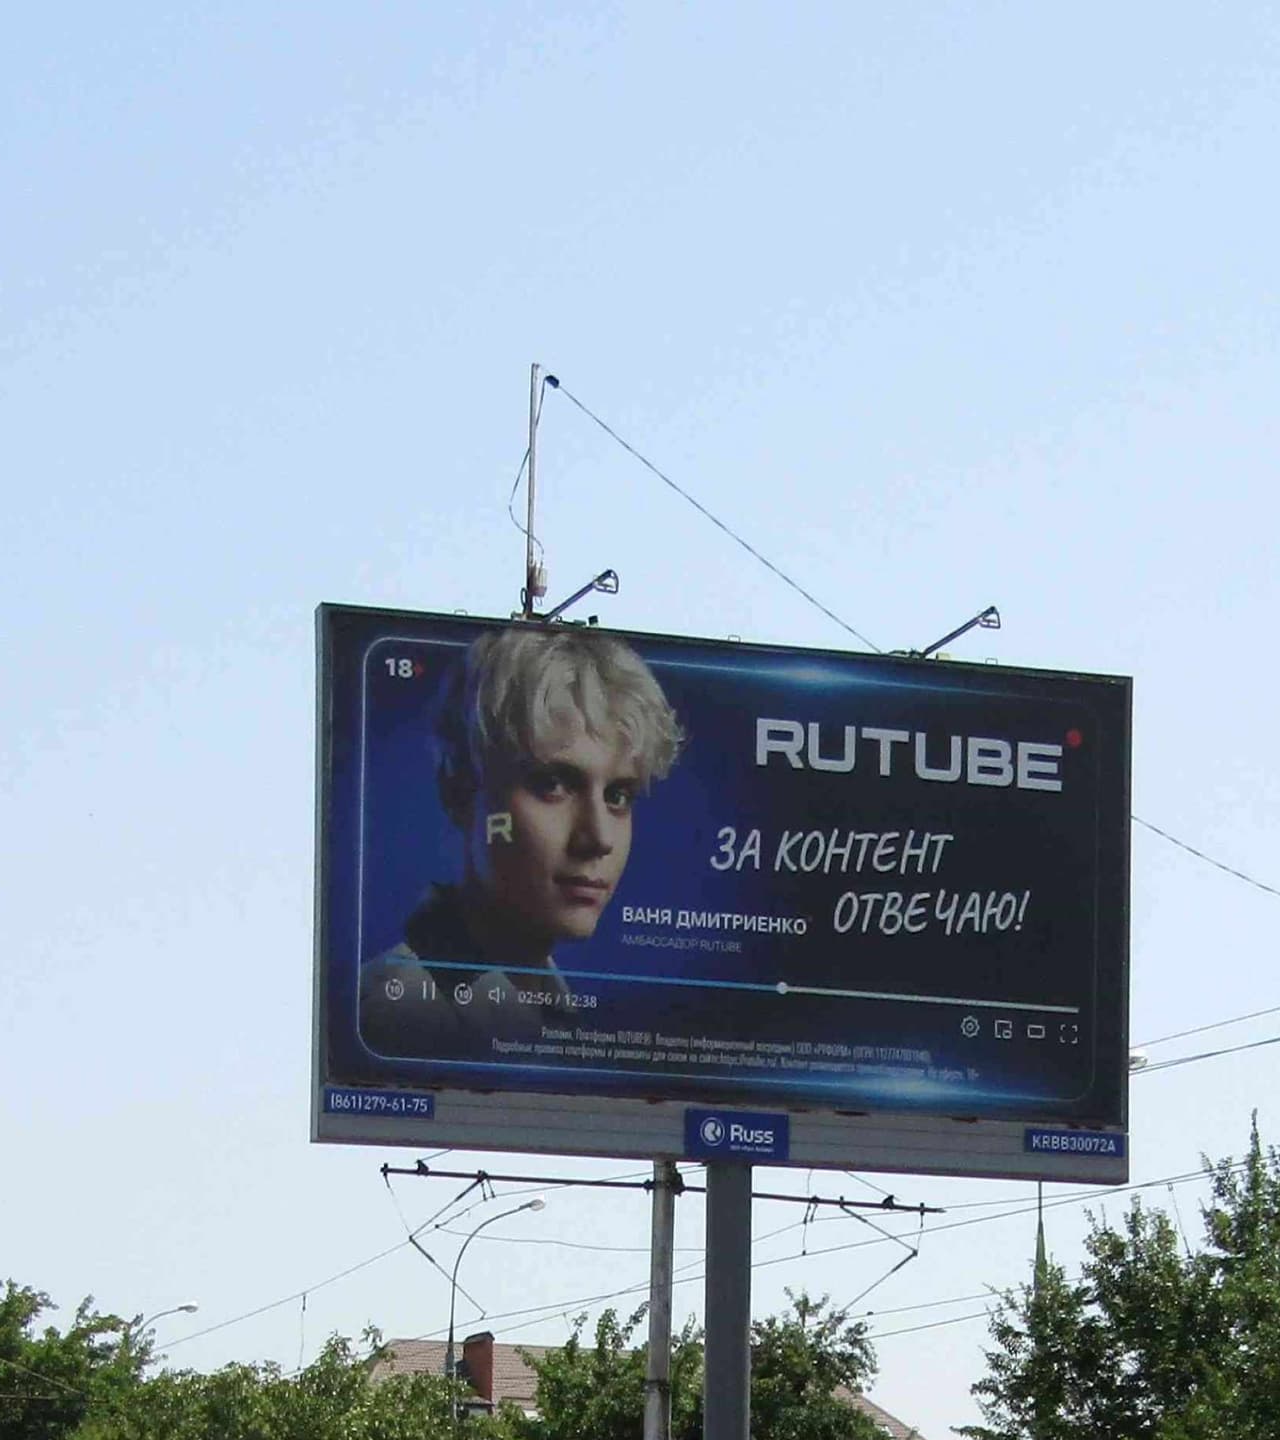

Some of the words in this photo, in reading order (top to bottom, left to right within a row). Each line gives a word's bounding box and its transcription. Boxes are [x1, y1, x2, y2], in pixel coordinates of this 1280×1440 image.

[755, 717, 1064, 792] RUTUBE
[486, 811, 513, 845] R
[709, 826, 761, 872] ЗА
[773, 827, 955, 875] КОНТЕНТ
[622, 905, 672, 925] ВАНЯ
[675, 910, 808, 935] ДМИТРИЕНКО
[832, 888, 1032, 936] ОТВЕЧАЮ!
[518, 991, 553, 1006] 02:56
[564, 993, 598, 1009] 12:38
[730, 1124, 774, 1144] Russ
